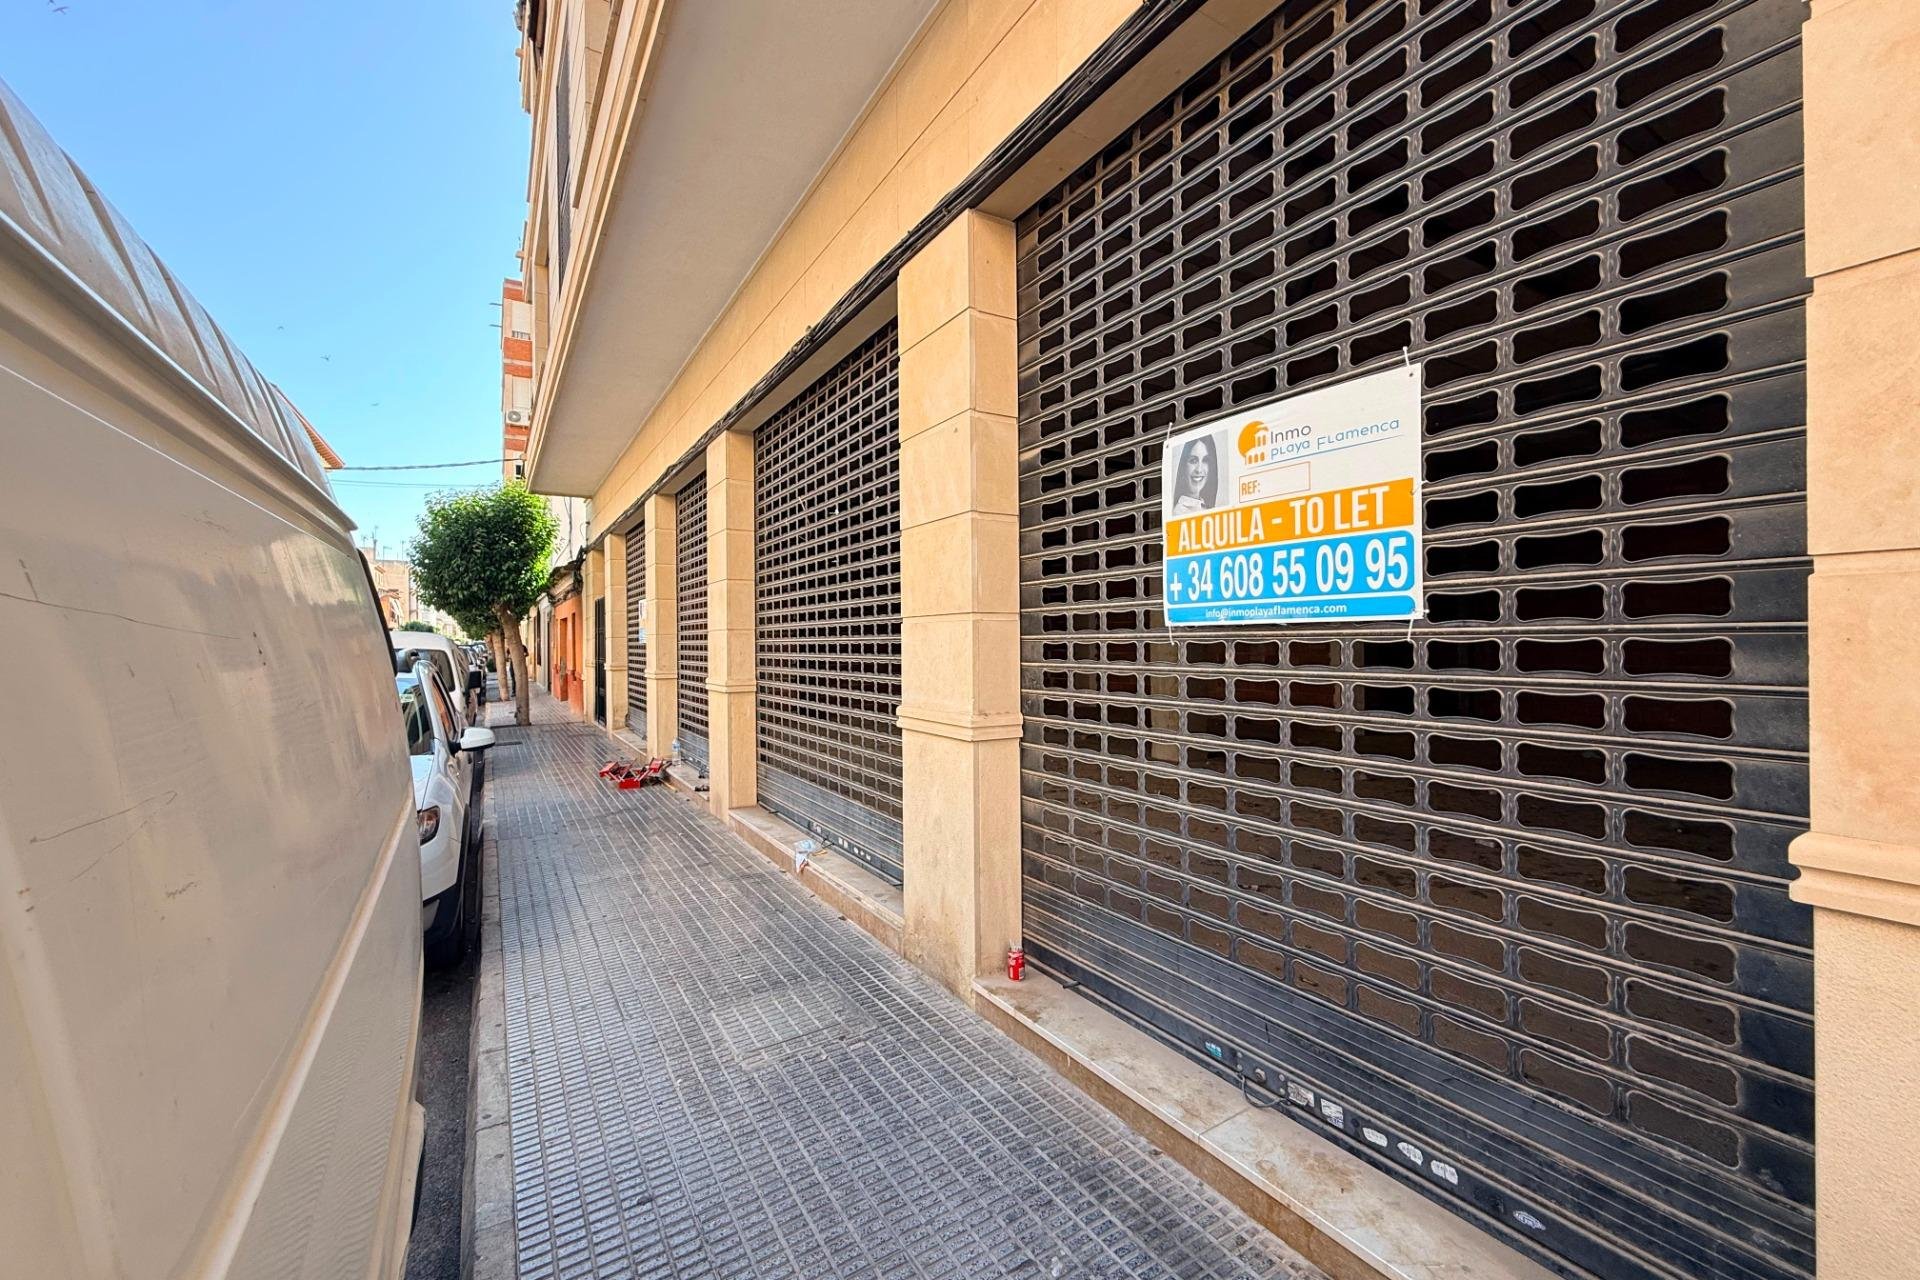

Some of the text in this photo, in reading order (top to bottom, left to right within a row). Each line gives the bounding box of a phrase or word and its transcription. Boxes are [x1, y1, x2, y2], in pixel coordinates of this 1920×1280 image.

[1270, 425, 1312, 444] Inmo
[1241, 480, 1261, 496] REF:
[1178, 485, 1390, 552] ALQUILA - TO LET
[1170, 536, 1408, 602] + 34 608 55 09 95
